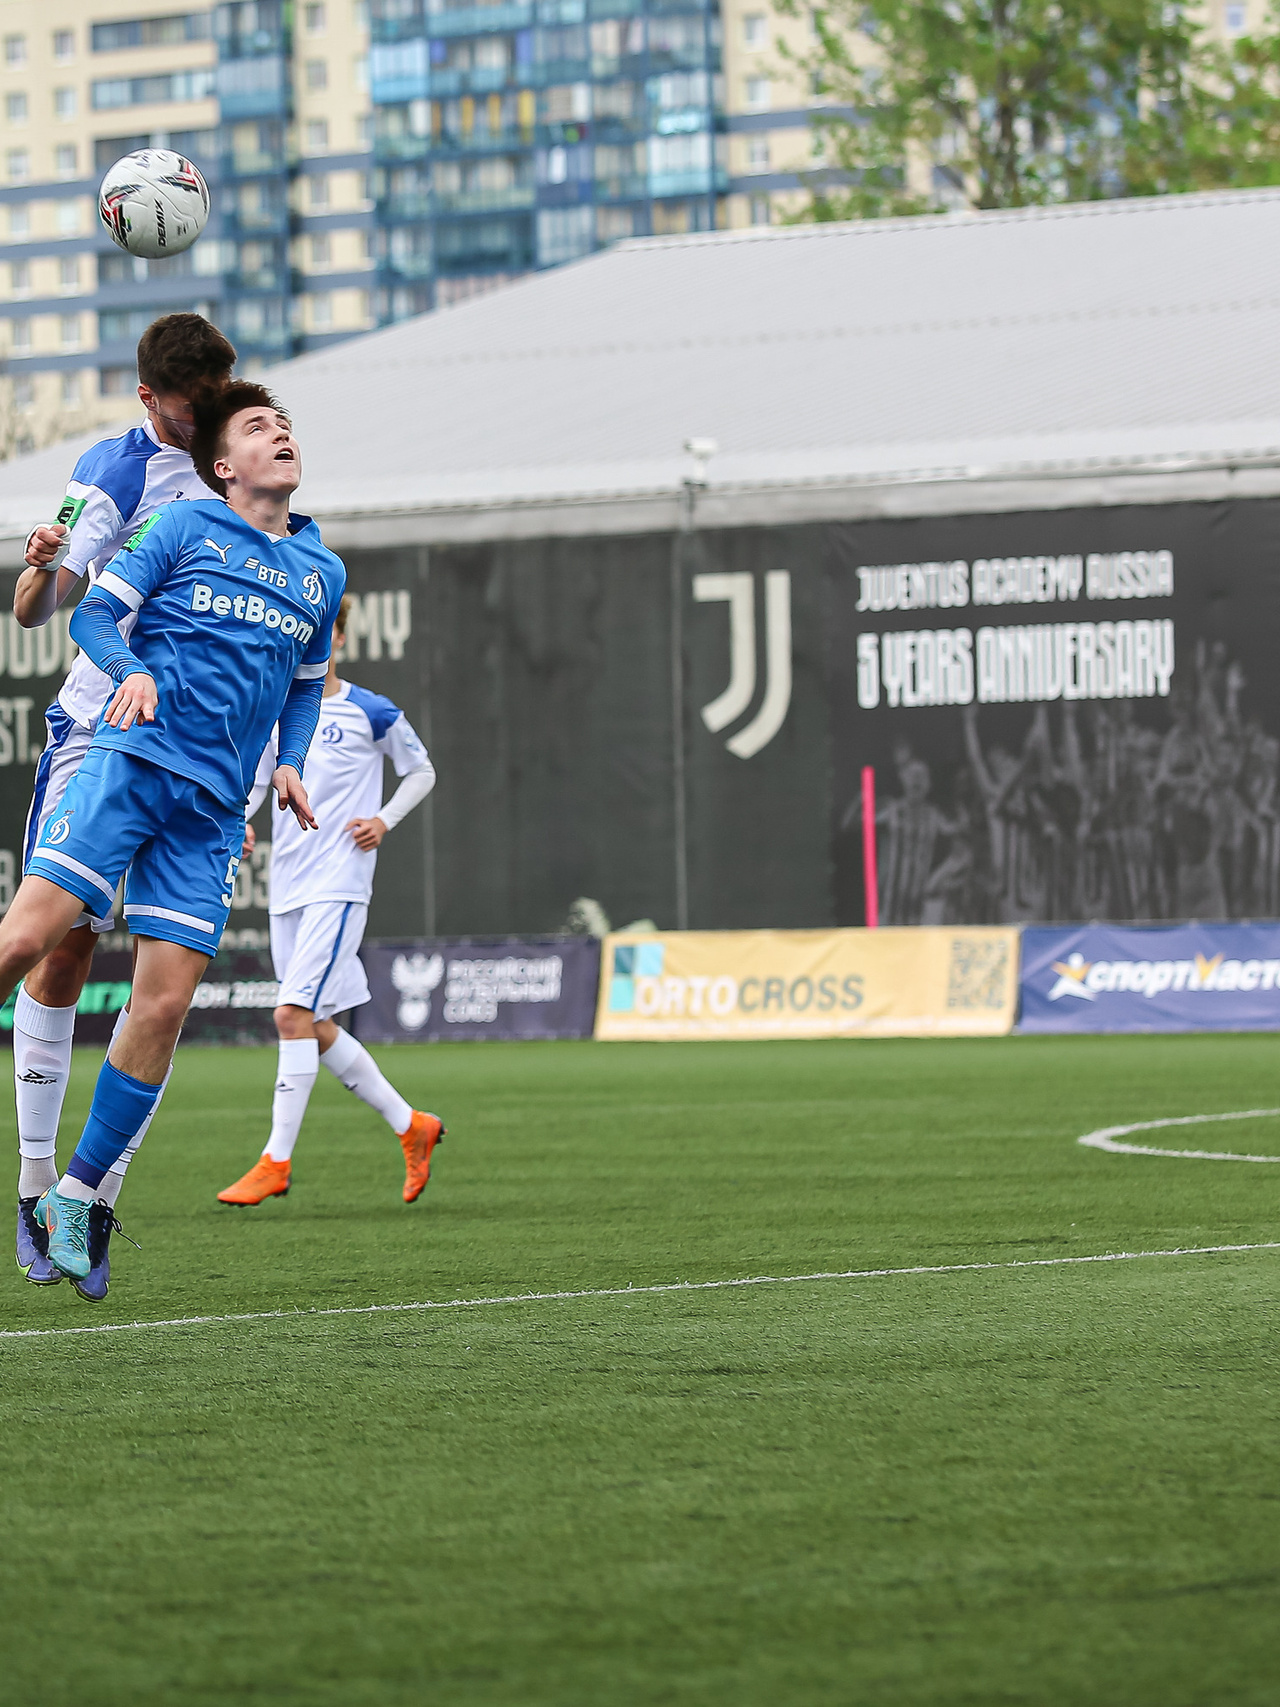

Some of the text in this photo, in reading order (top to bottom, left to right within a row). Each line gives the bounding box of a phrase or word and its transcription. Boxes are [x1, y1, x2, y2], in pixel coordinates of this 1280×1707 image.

[257, 564, 288, 588] ВТБ
[856, 549, 1174, 612] JUVENTUS ACADEMY RUSSIA
[191, 584, 314, 644] BetBoom
[857, 618, 1175, 709] 5 YEARS ANNIVERSARY
[635, 975, 866, 1017] ORTOCROSS
